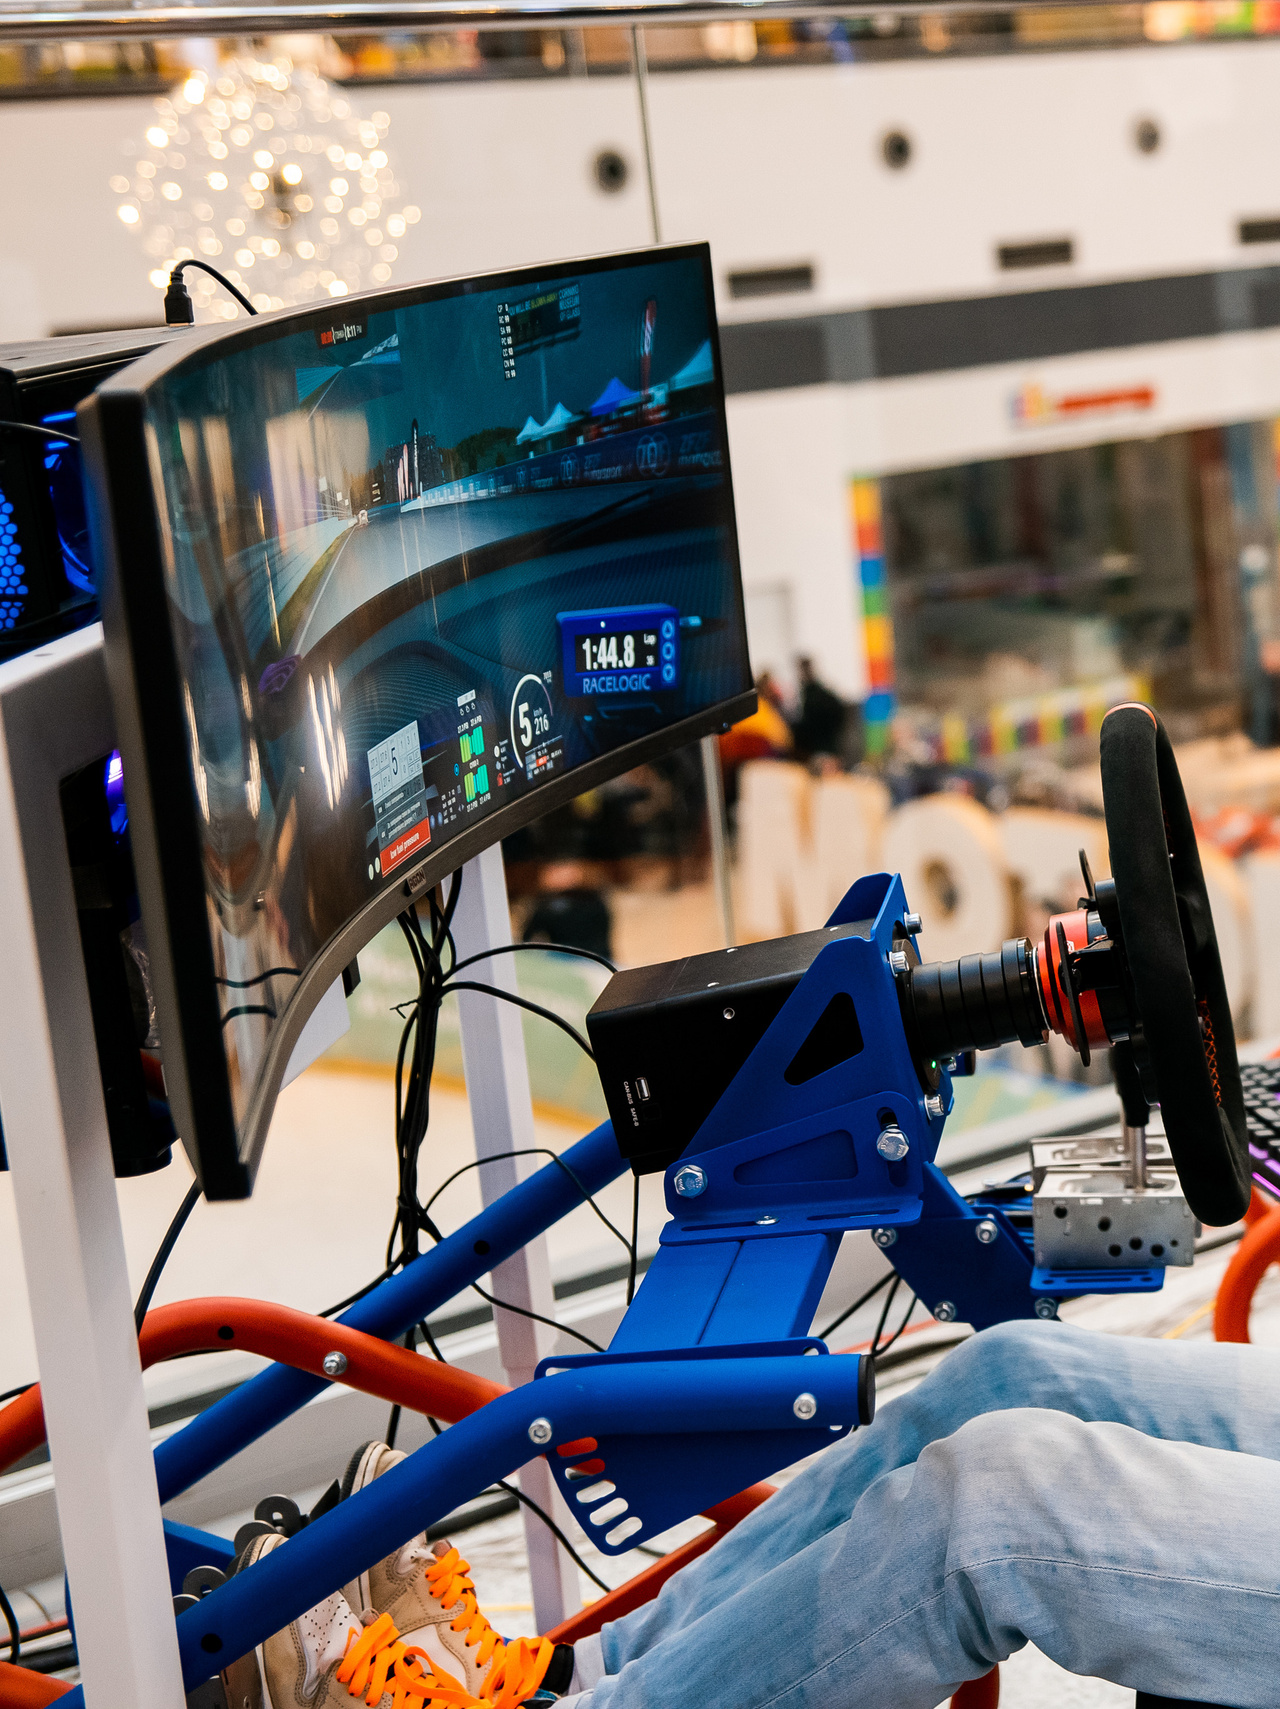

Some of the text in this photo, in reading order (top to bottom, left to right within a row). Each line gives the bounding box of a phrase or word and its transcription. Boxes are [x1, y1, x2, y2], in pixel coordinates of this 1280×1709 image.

[582, 634, 636, 671] 1:44.8
[582, 673, 652, 694] RACELOGIC
[518, 702, 533, 748] 5
[534, 713, 550, 736] 216
[390, 746, 399, 776] 5
[403, 832, 420, 852] pressure
